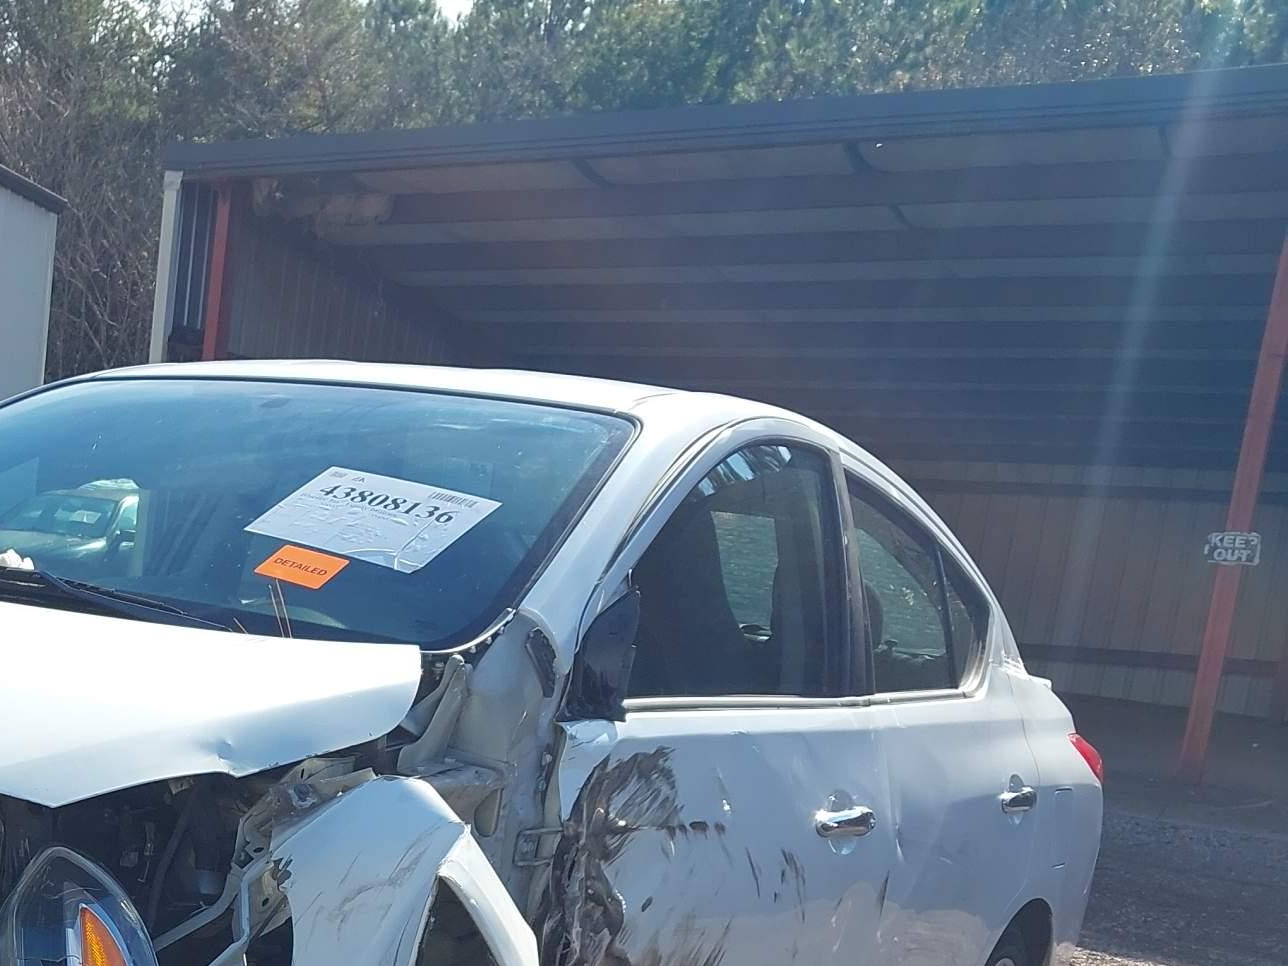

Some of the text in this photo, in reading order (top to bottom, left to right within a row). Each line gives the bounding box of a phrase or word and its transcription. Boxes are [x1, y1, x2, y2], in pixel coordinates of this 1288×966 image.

[320, 485, 460, 523] 43808136
[1213, 548, 1252, 561] OUT
[273, 556, 327, 577] DETAILED
